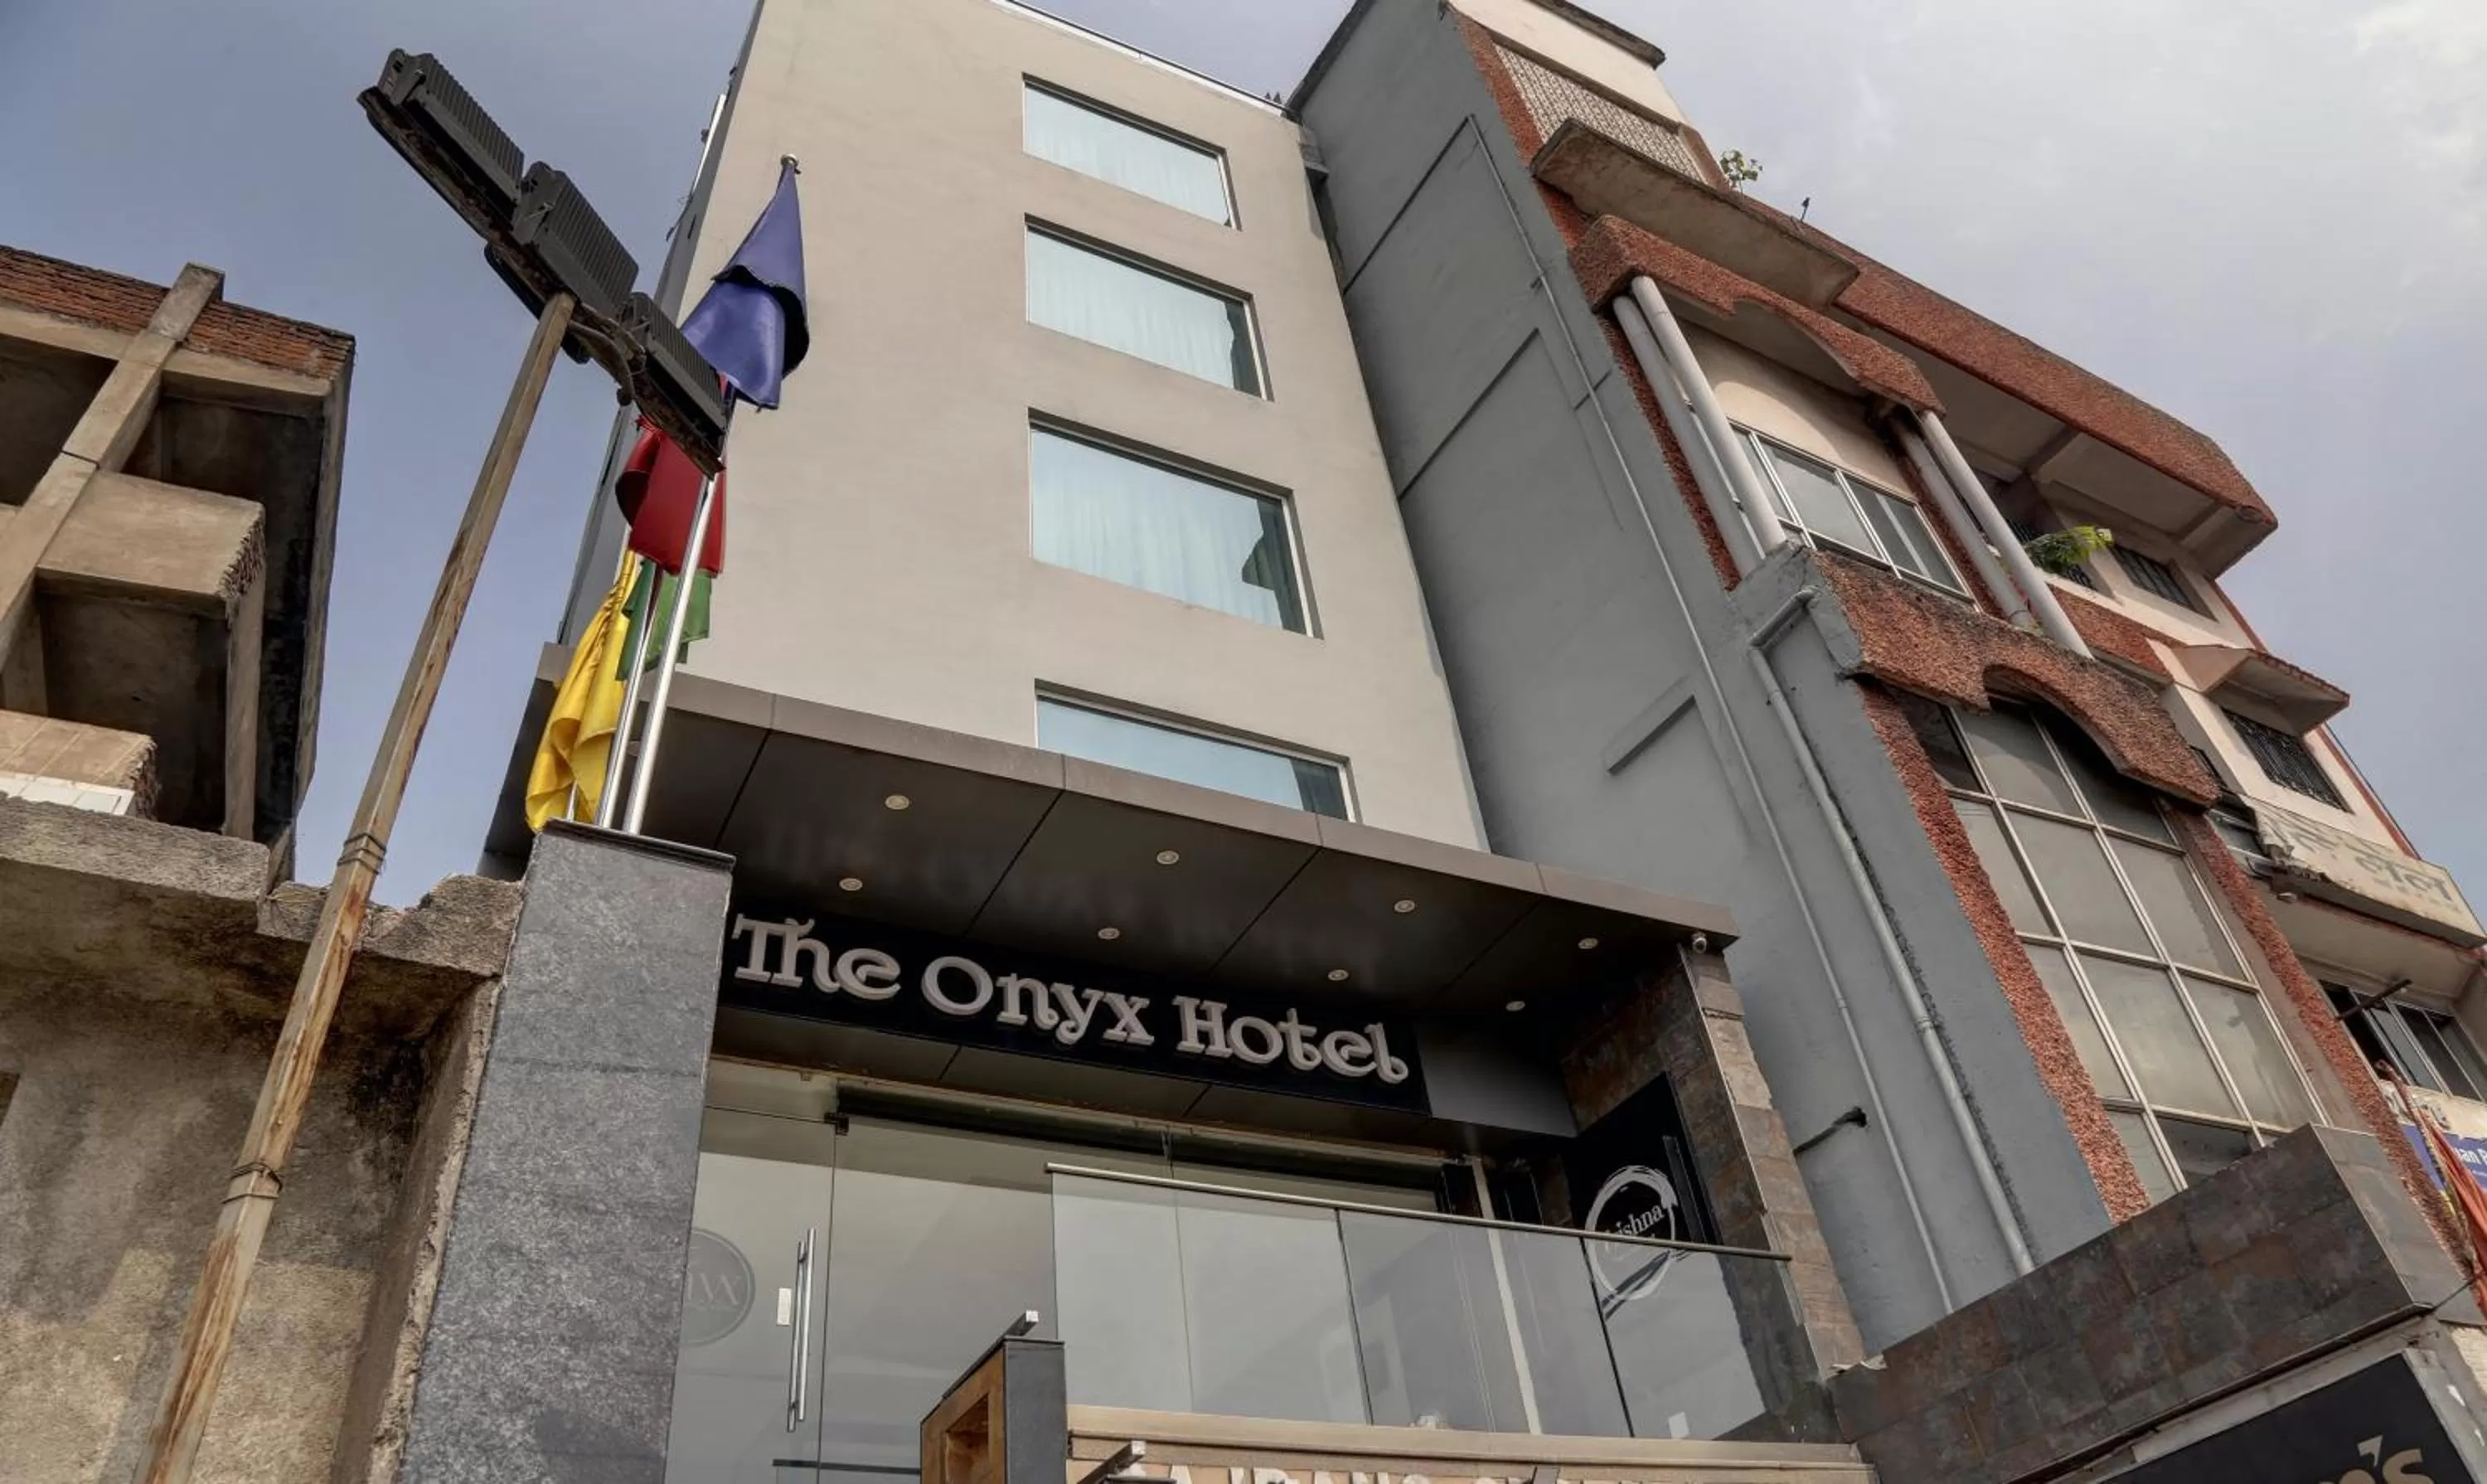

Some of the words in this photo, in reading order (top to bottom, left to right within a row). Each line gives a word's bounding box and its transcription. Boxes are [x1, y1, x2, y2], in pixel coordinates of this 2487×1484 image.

[732, 914, 901, 1000] The
[921, 956, 1155, 1045] Onyx
[1171, 995, 1408, 1084] Hotel
